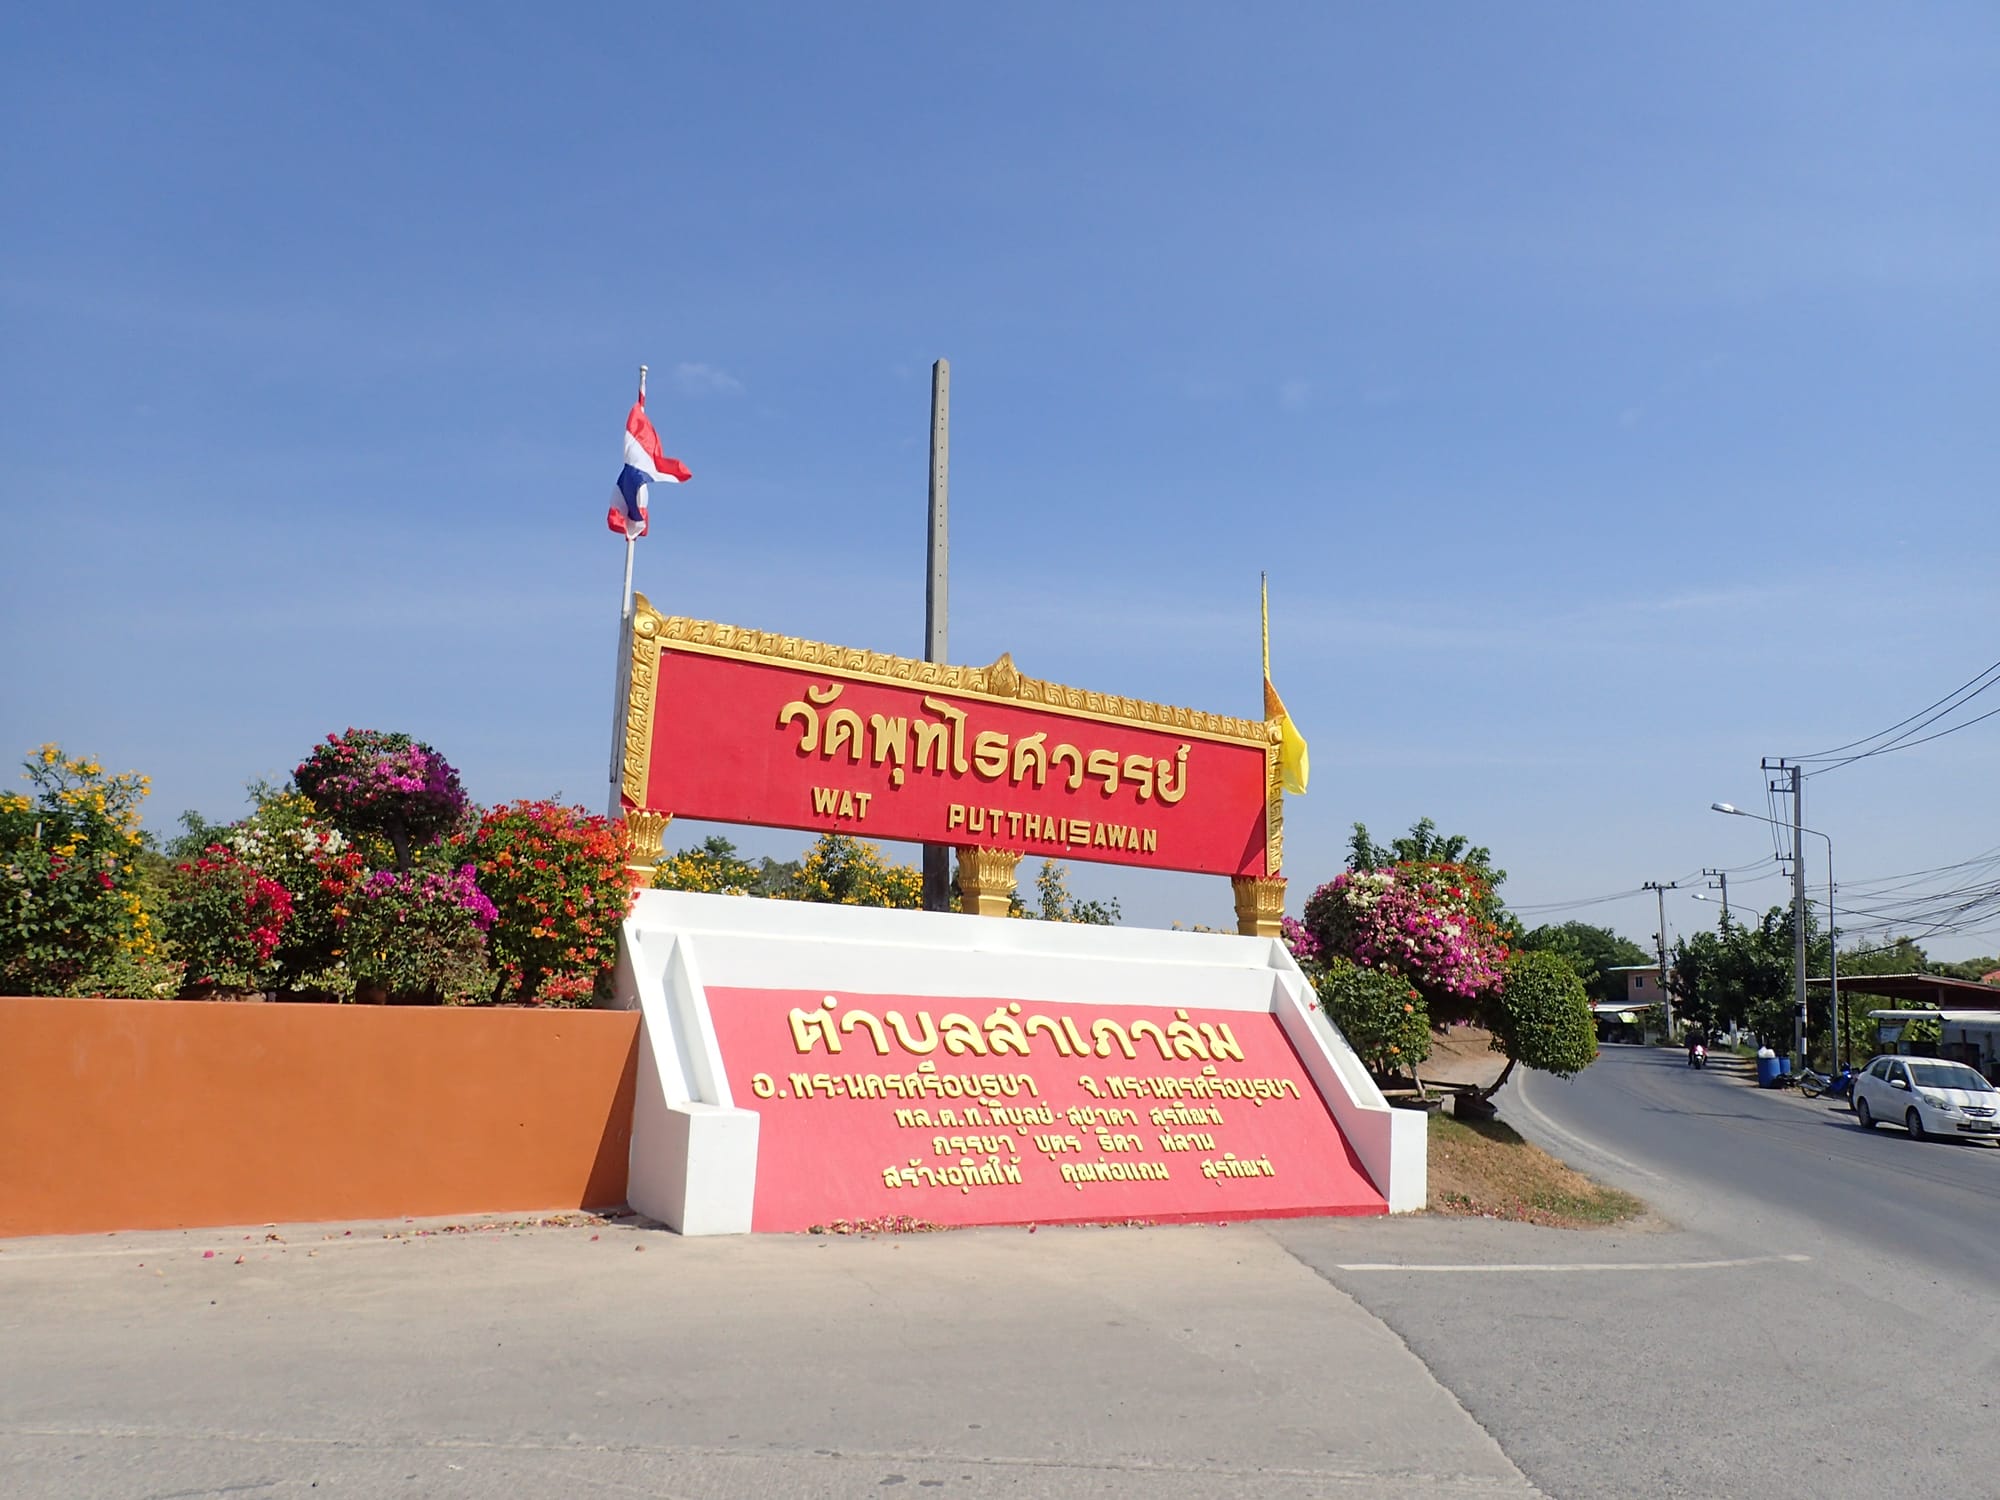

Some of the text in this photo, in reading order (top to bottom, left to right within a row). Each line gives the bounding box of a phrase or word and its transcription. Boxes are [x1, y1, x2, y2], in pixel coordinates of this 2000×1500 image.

[778, 683, 1191, 803] วัดพุทไธศวรรย์
[814, 787, 1157, 852] WAT PUTTHAISAWAN
[788, 999, 1245, 1061] ตำบลสำเภาล่ม
[882, 1155, 1023, 1194] สร้างอุทิศให้
[1034, 1134, 1082, 1161] บุตร
[1095, 1127, 1143, 1153] ธิดา
[1159, 1133, 1216, 1152] หลาน
